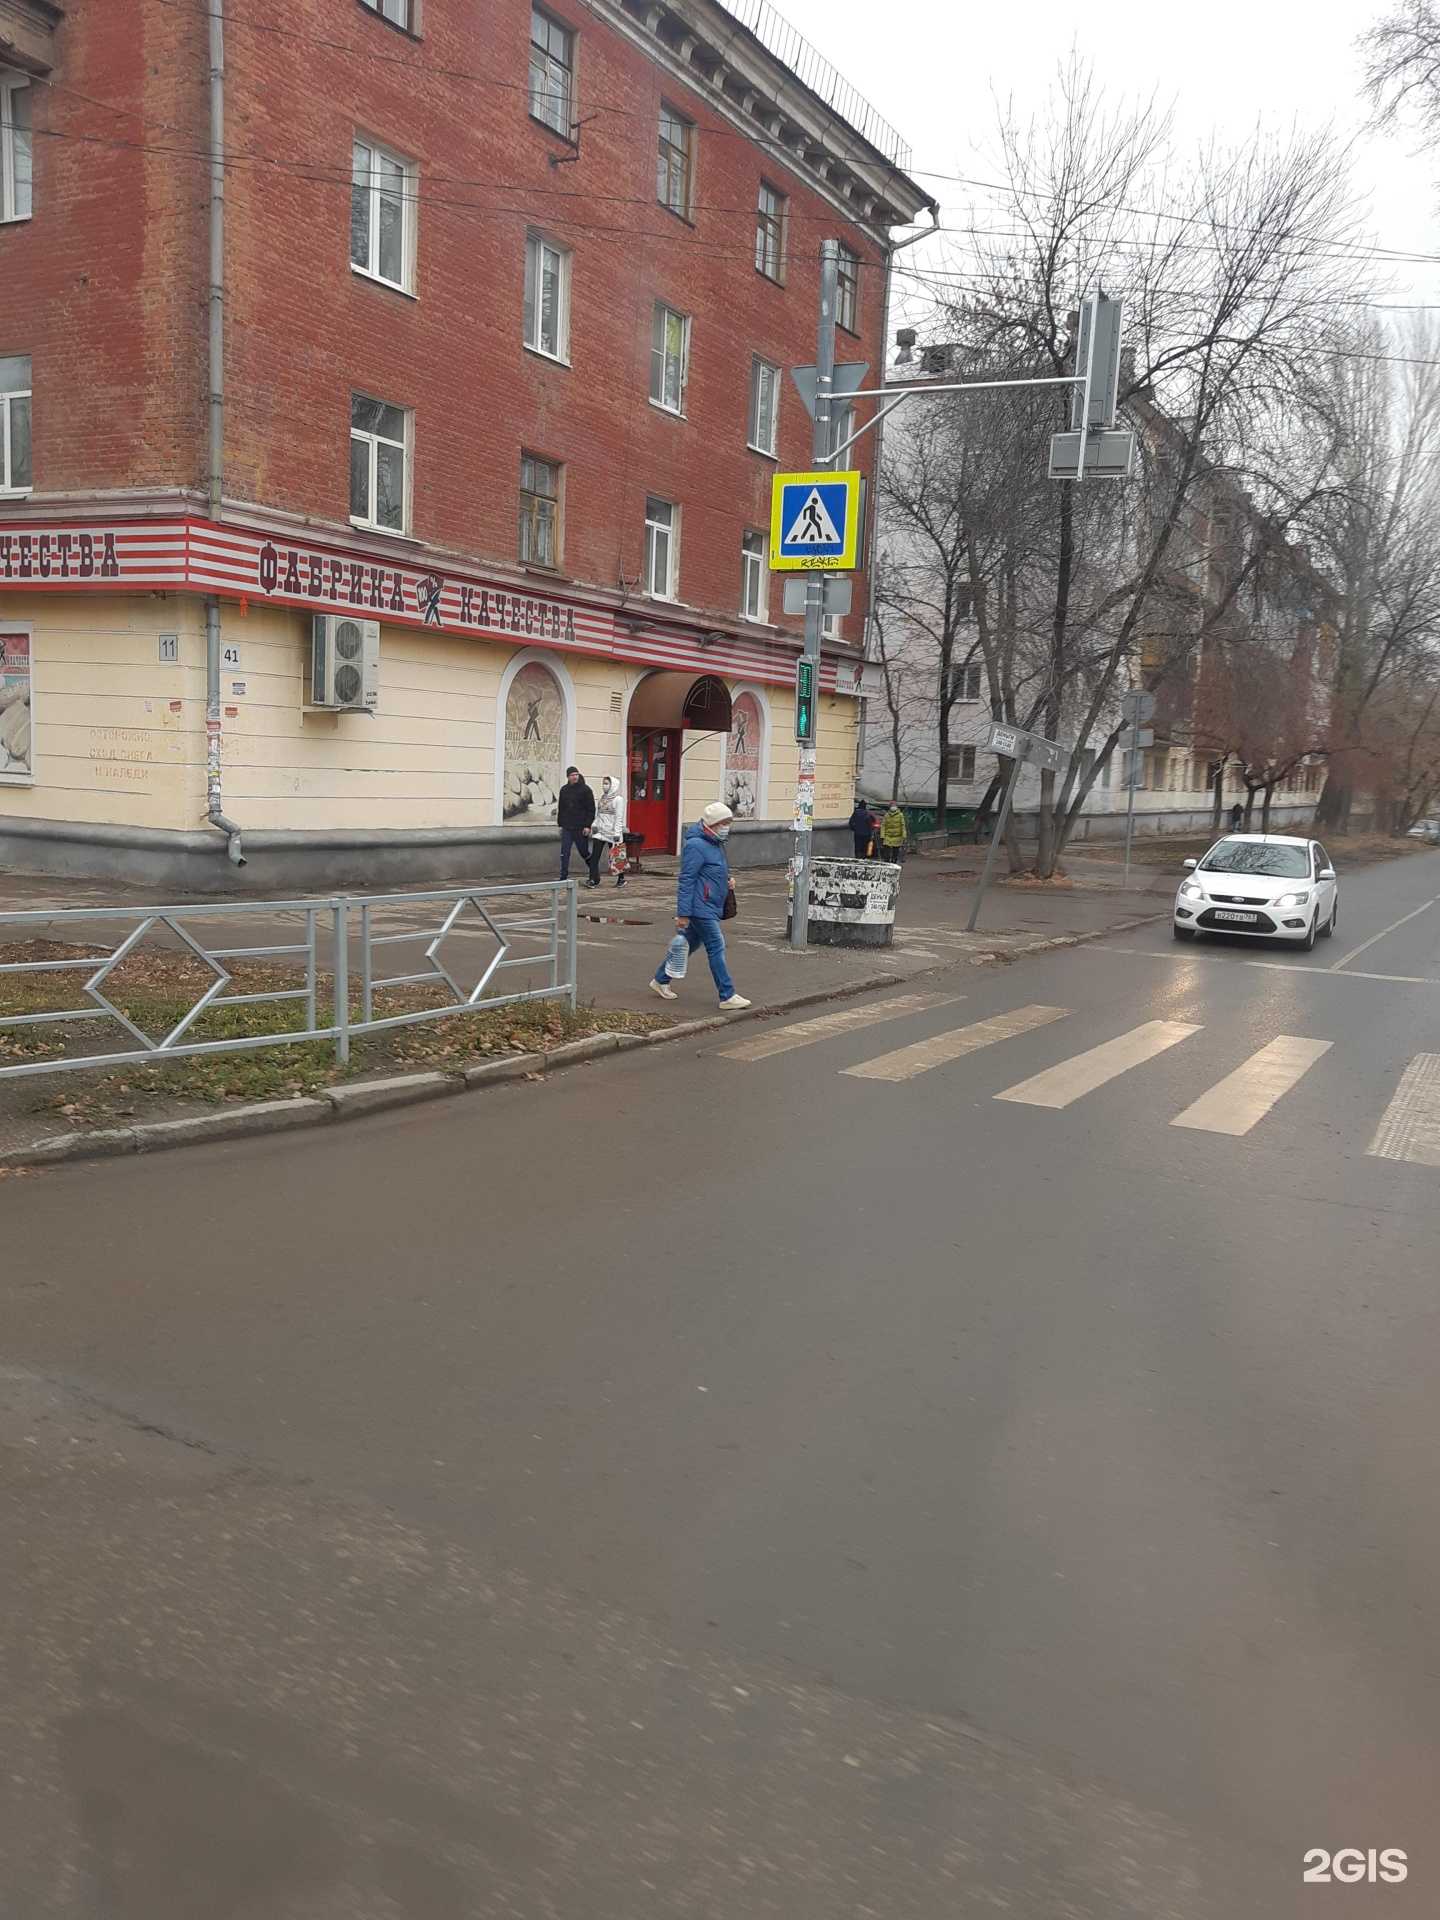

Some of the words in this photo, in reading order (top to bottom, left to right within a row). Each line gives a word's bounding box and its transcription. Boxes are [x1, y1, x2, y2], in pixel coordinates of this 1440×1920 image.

[259, 541, 405, 612] ФАБРИКА
[460, 586, 576, 642] КАЧЕСТВА
[161, 639, 175, 657] 11
[224, 648, 239, 663] 41
